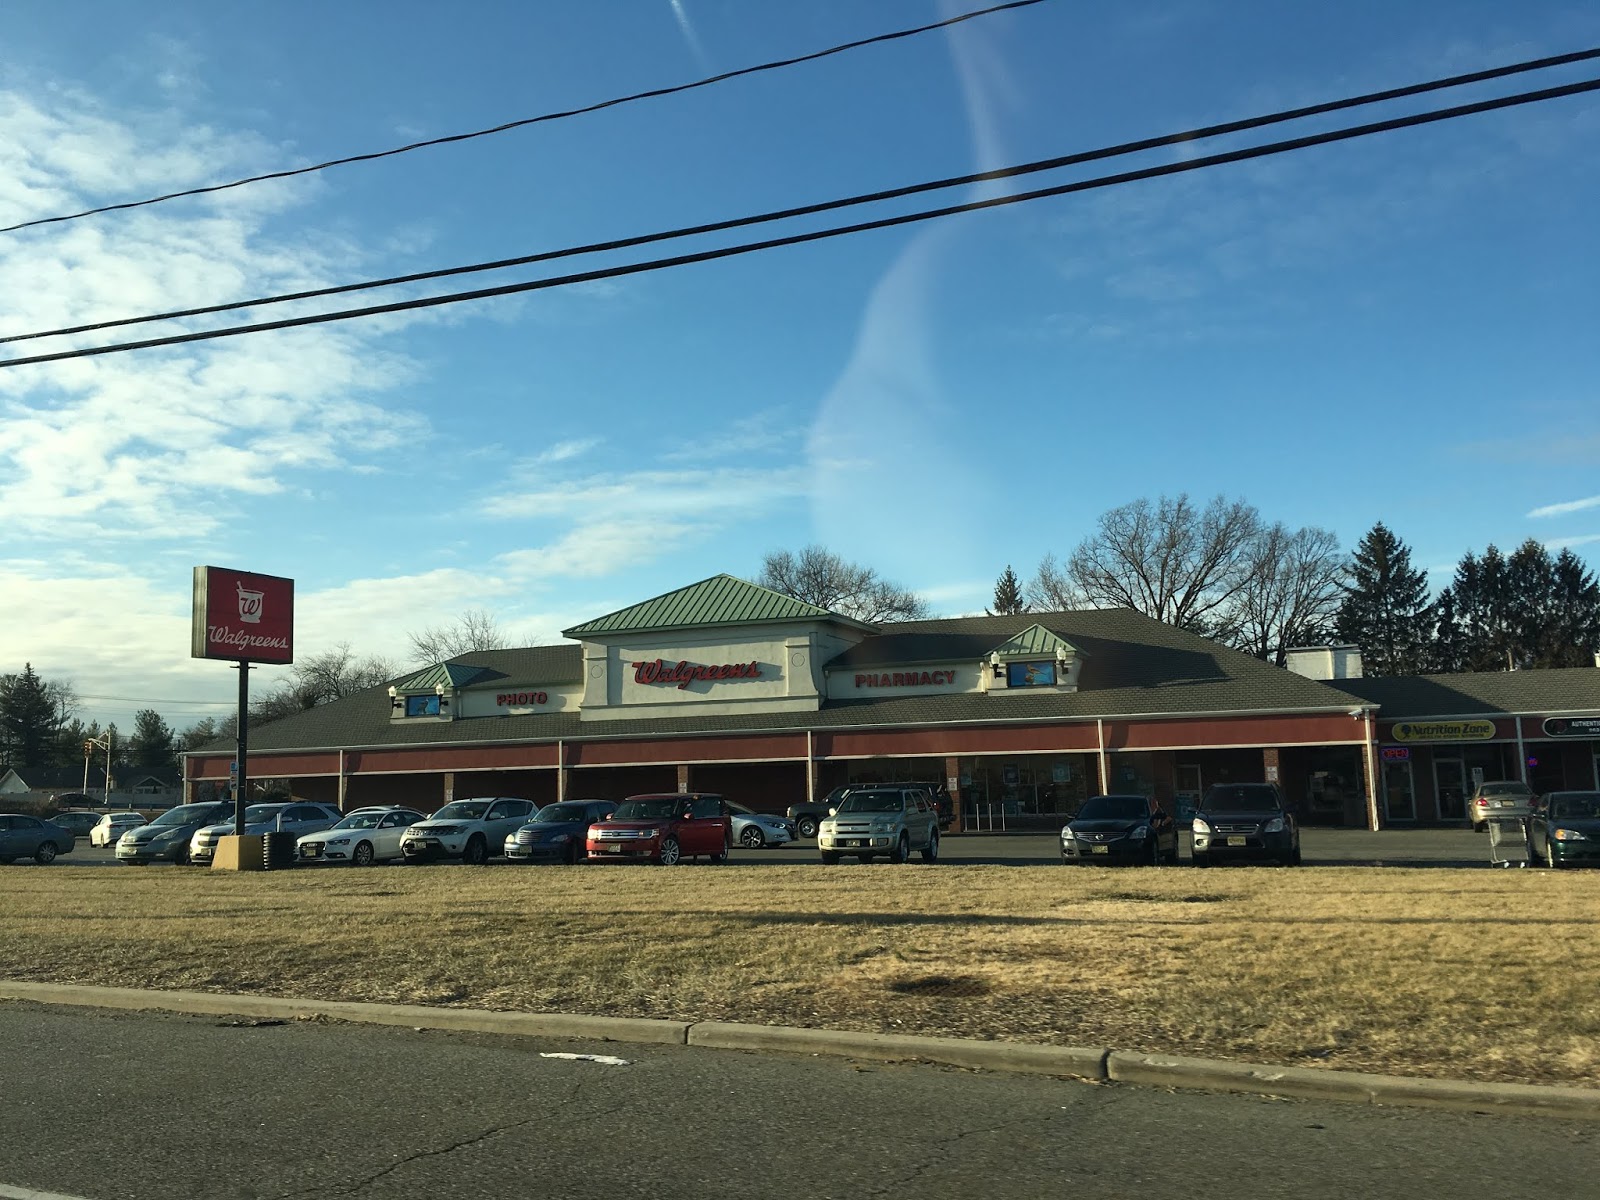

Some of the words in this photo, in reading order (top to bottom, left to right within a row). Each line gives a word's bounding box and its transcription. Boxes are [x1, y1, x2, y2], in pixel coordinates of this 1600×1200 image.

[208, 625, 289, 651] Walgreens
[631, 658, 763, 690] Walgreens
[855, 670, 956, 688] PHARMACY
[496, 691, 548, 706] PHOTO
[1412, 723, 1461, 735] Nutrition
[1462, 723, 1490, 734] Zone
[1384, 749, 1408, 758] OPEN
